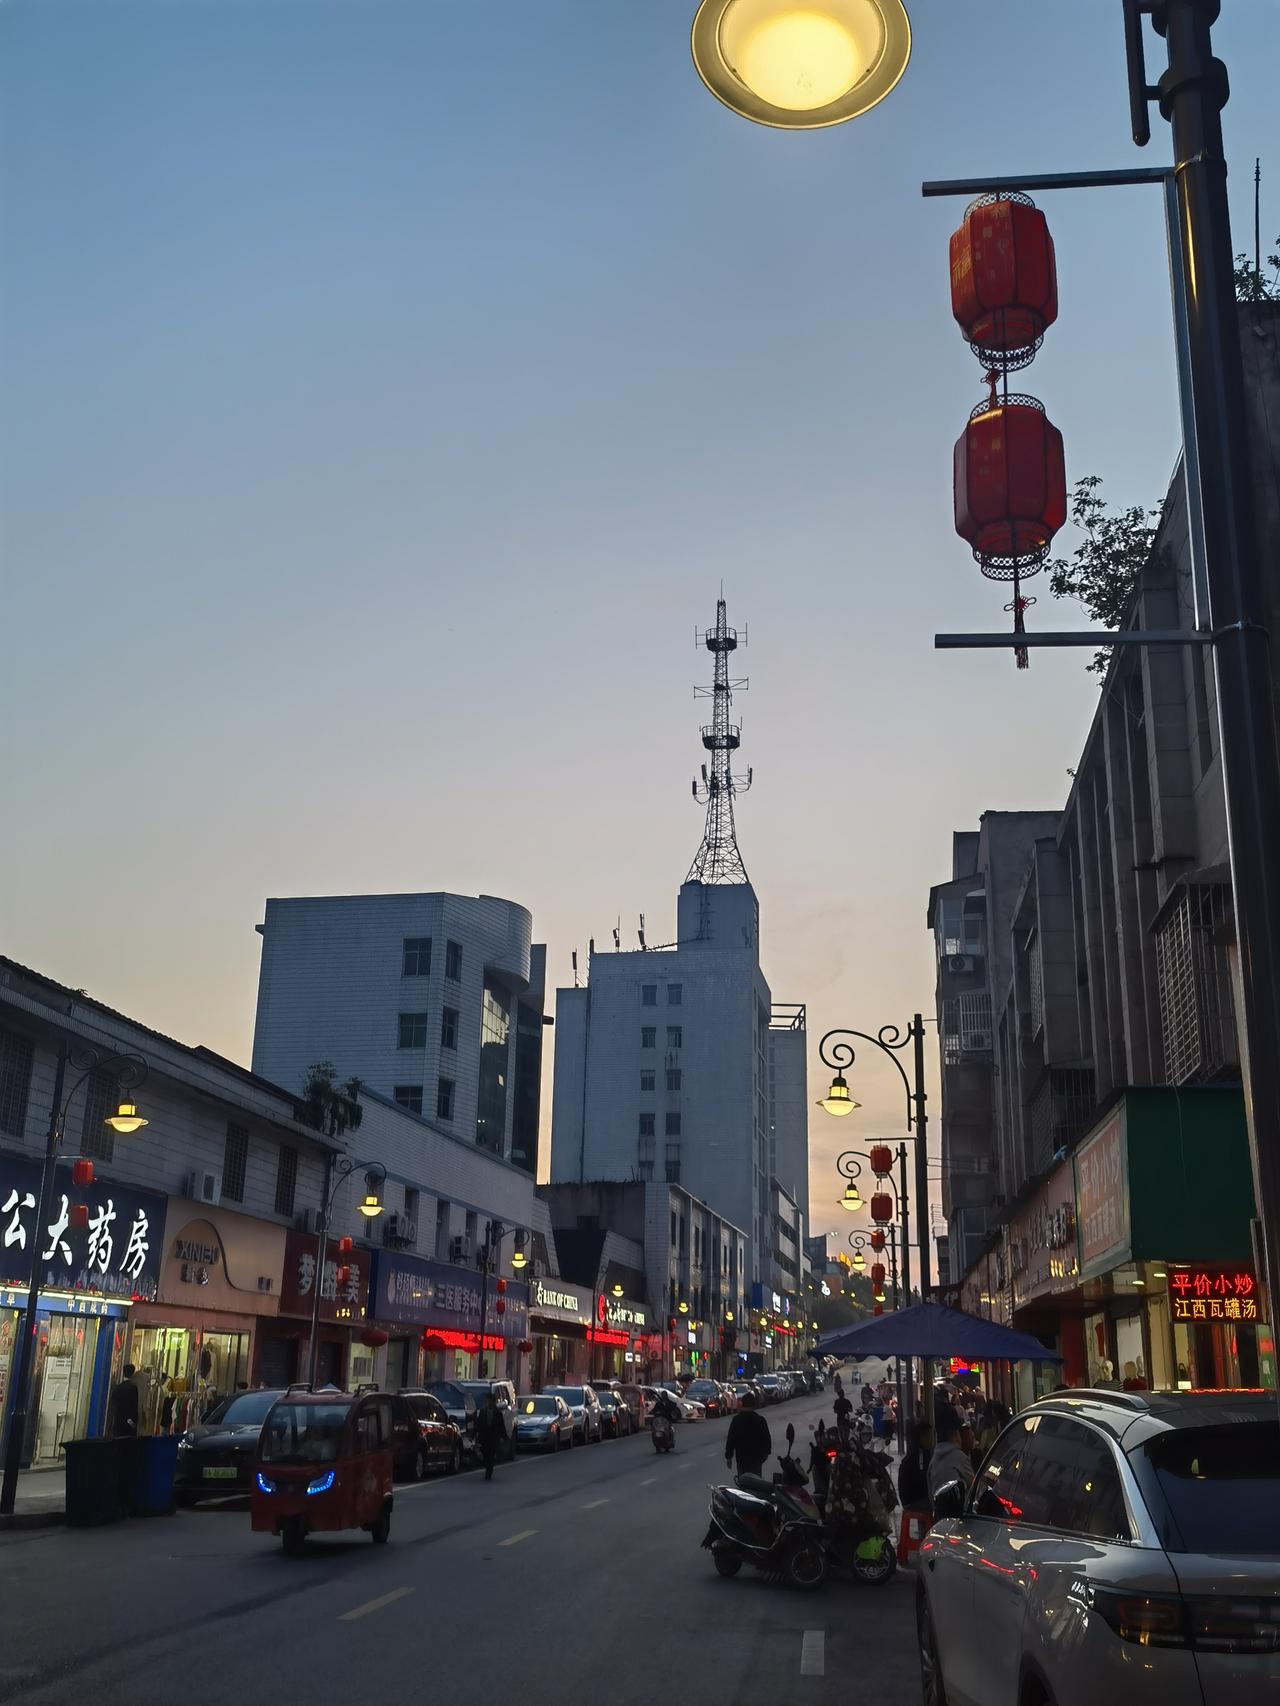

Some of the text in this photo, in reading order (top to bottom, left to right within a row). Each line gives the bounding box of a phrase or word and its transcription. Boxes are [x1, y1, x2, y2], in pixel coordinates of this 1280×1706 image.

[1172, 1274, 1254, 1296] 平价小炒
[1175, 1298, 1256, 1320] 江西瓦罐汤
